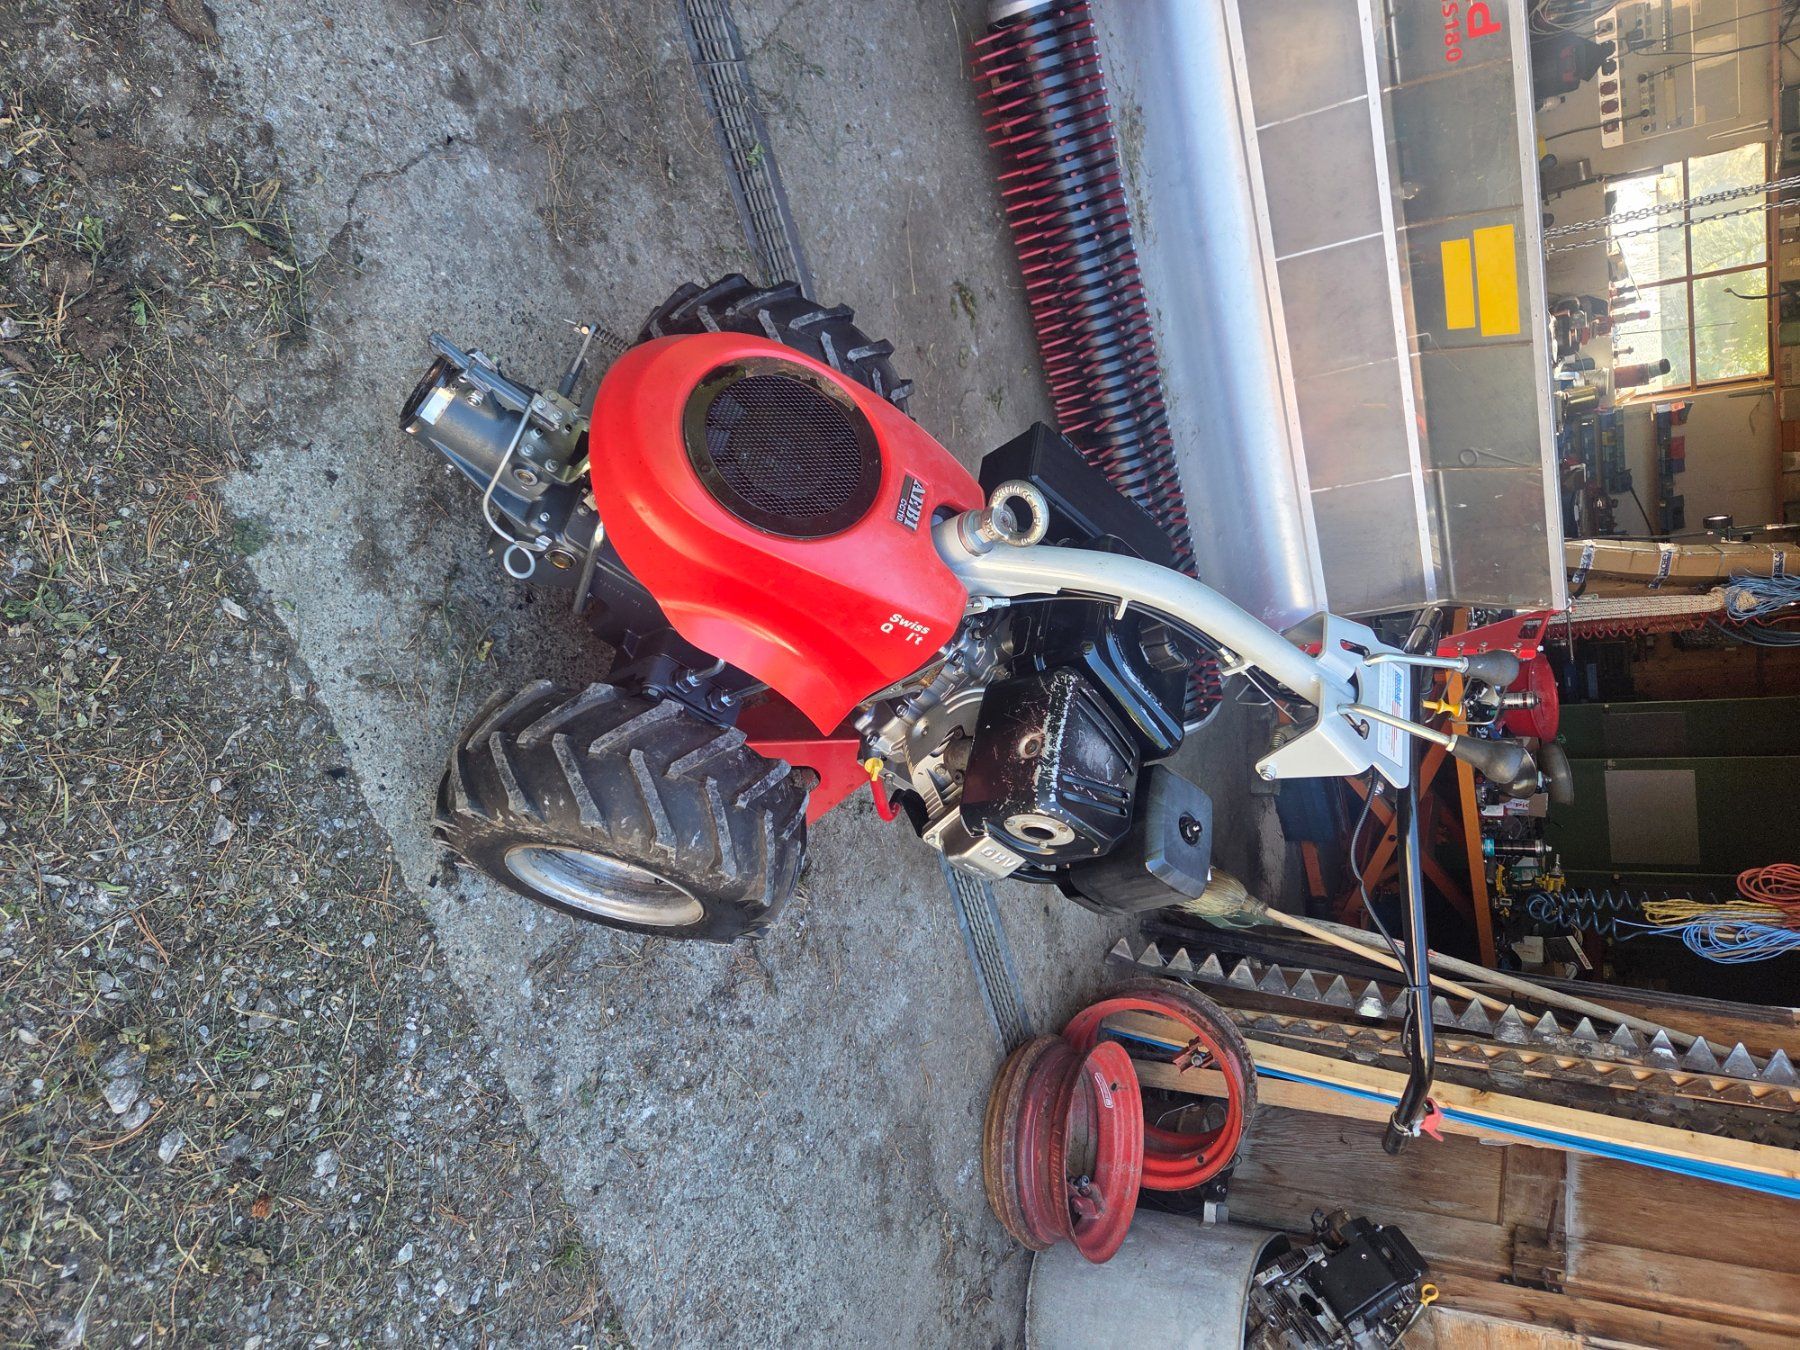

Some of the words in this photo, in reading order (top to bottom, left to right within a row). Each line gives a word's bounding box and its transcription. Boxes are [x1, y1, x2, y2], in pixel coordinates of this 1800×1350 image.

[903, 479, 926, 531] AEBI
[889, 613, 931, 635] Swiss
[980, 845, 1018, 869] OHV
